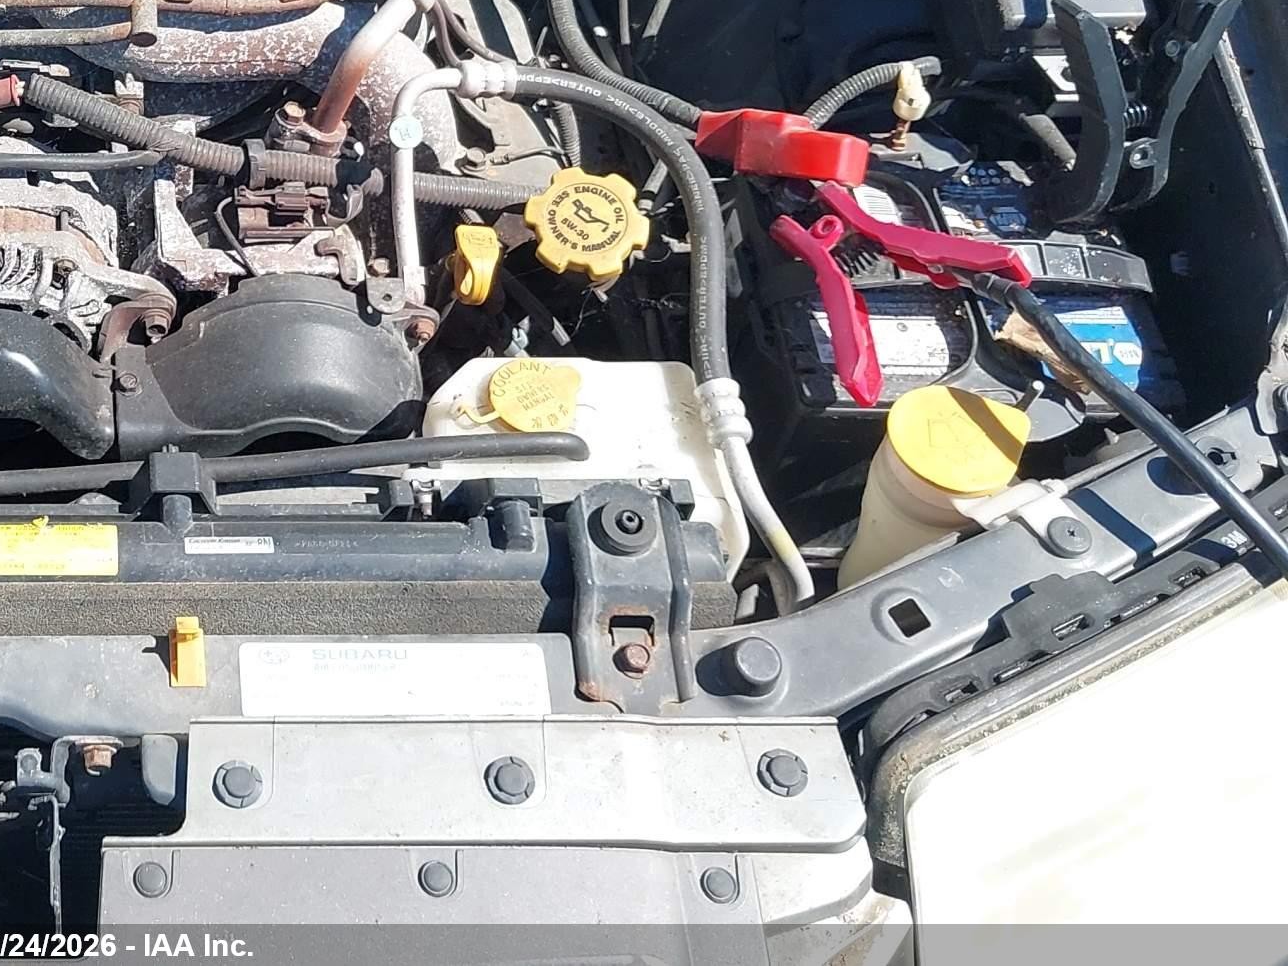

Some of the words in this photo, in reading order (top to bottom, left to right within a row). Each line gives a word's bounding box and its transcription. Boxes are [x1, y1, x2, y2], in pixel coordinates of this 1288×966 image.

[551, 190, 571, 208] SEE
[581, 229, 622, 252] MANUAL
[573, 185, 618, 206] ENGINE
[613, 206, 624, 224] OIL
[492, 361, 552, 398] COOLANT
[311, 648, 409, 660] SUBARU
